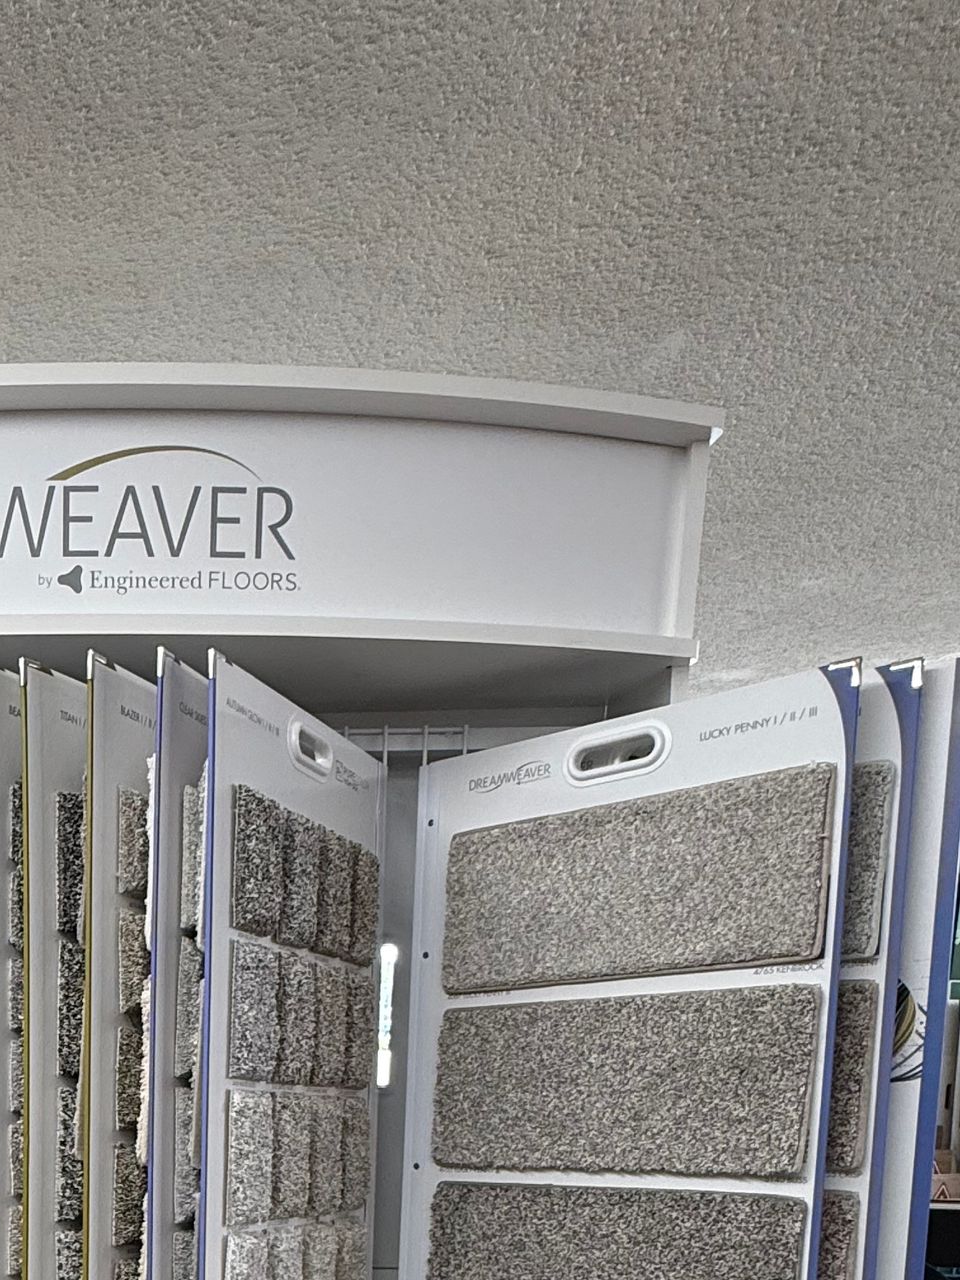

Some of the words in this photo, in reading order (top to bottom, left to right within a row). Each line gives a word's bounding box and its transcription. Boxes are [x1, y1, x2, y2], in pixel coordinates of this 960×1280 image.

[38, 573, 53, 588] by
[90, 569, 202, 595] Engineered
[699, 726, 732, 742] LUCKY
[734, 716, 772, 734] PENNY
[468, 762, 551, 792] DREAMWEAVER
